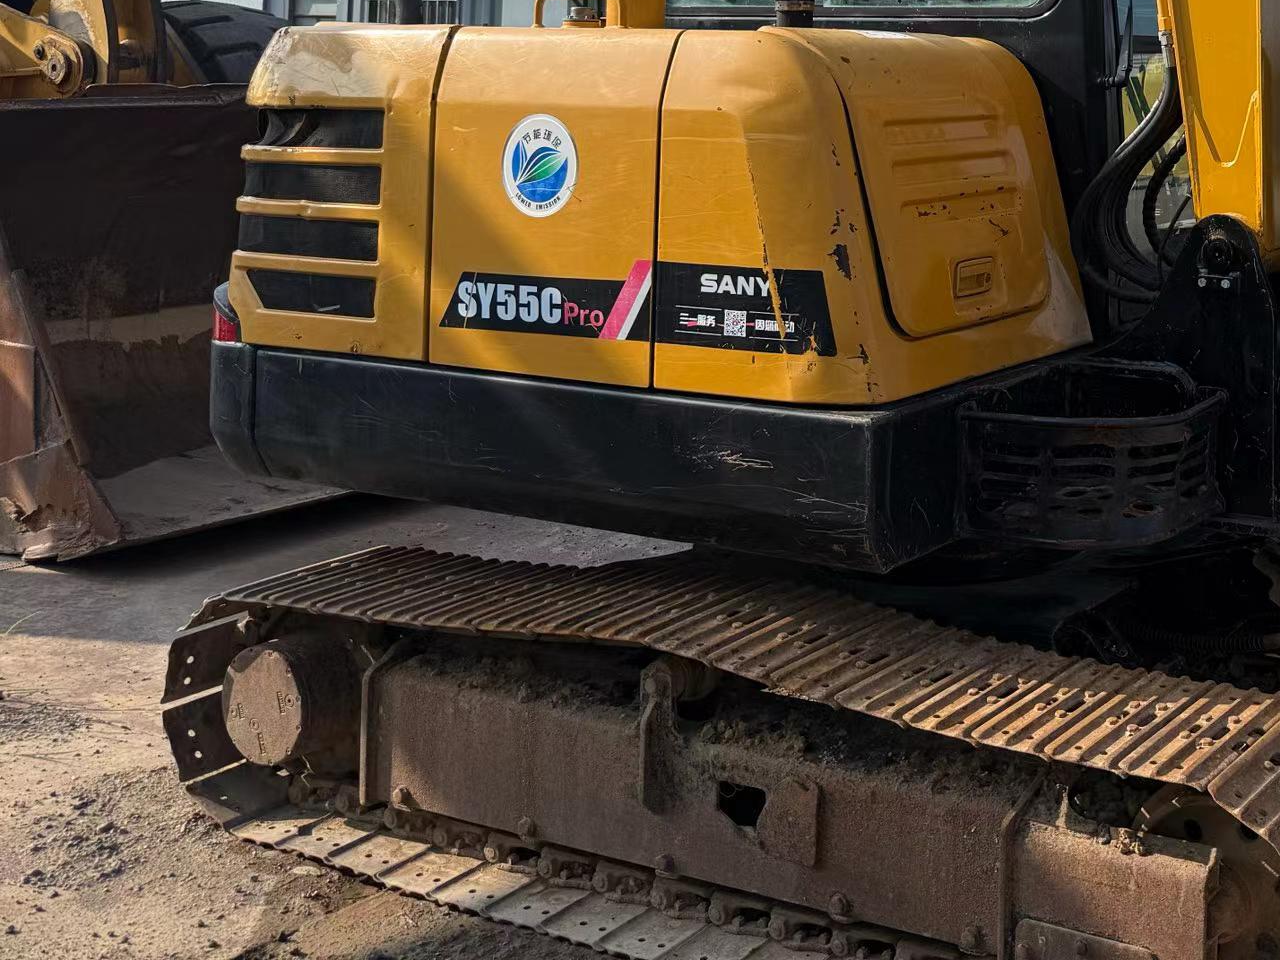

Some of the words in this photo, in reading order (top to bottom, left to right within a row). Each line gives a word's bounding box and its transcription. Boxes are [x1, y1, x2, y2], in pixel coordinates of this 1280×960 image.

[522, 128, 562, 149] 节能环保
[535, 195, 561, 211] EMISSION
[700, 273, 771, 297] SANY
[457, 280, 562, 324] SY55C
[563, 302, 604, 327] Pro
